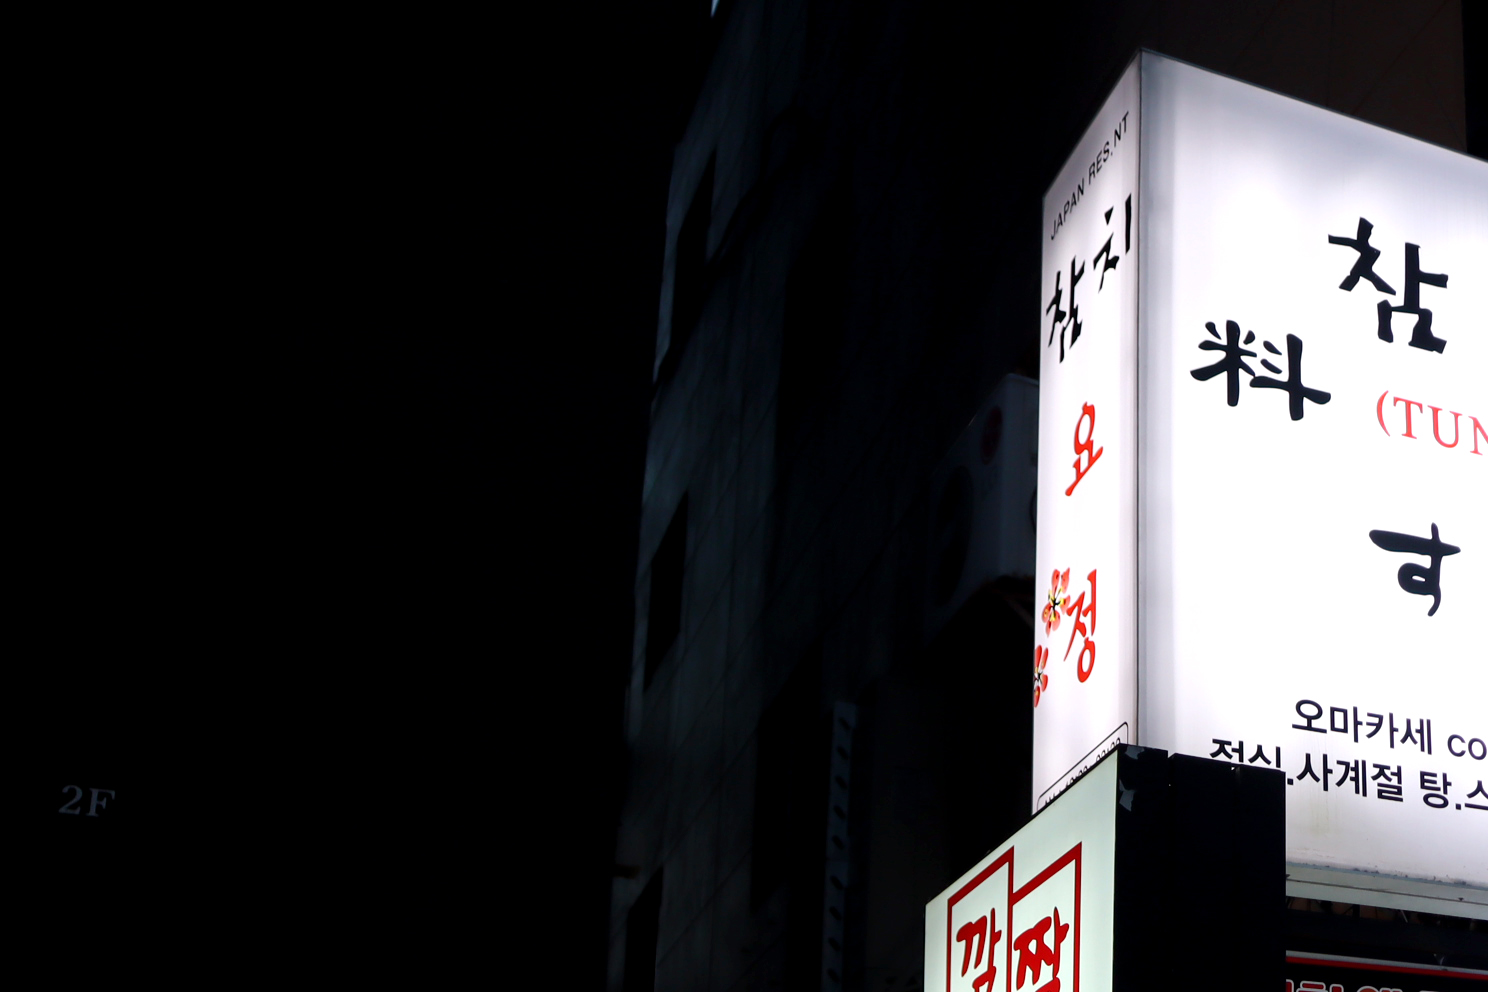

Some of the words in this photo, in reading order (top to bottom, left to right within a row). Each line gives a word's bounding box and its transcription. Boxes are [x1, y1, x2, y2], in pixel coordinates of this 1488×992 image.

[1050, 177, 1085, 241] JAPAN
[1046, 193, 1132, 364] 참치
[1291, 699, 1433, 755] 오마카세
[58, 784, 116, 818] 2F
